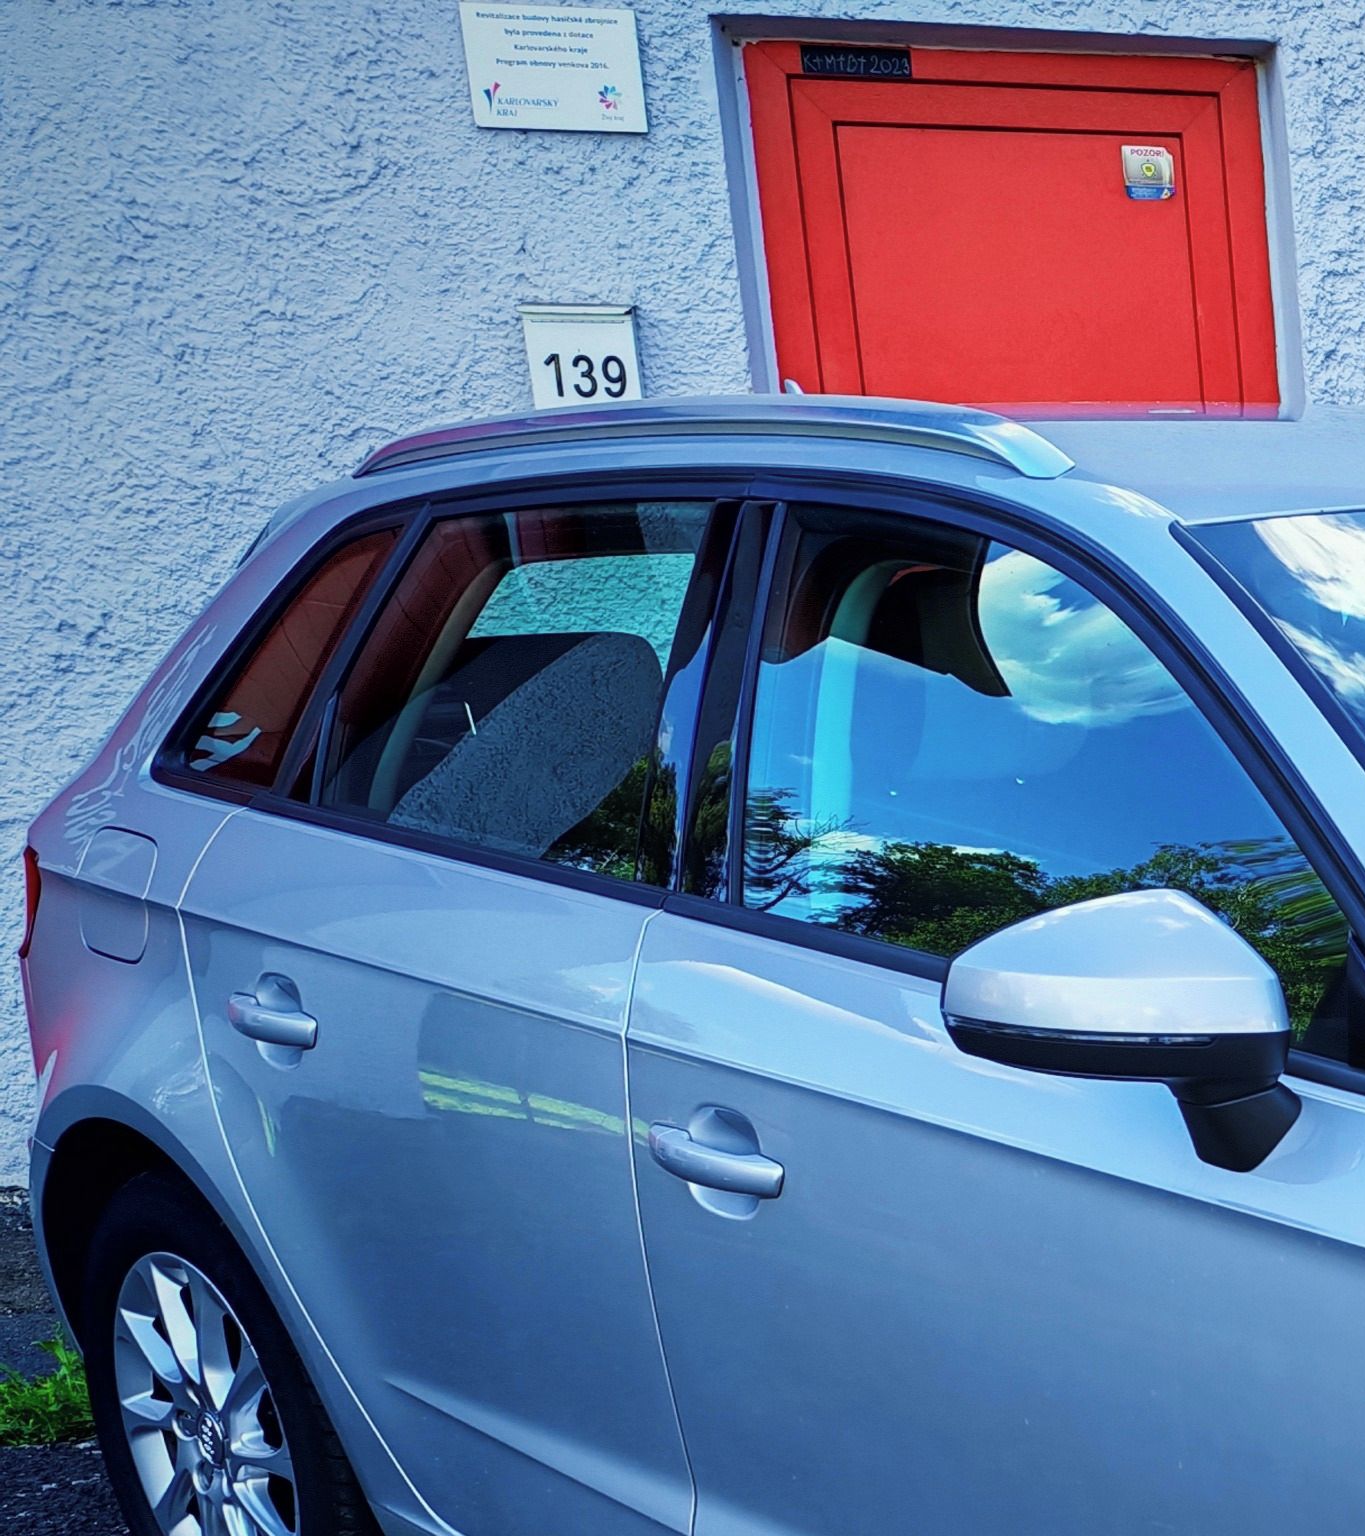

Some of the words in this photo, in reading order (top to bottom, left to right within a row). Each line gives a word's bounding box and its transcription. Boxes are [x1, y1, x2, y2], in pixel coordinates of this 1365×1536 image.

[476, 11, 520, 20] Revitalizace
[522, 14, 549, 23] budovy
[504, 28, 520, 36] byla
[522, 29, 561, 37] provedena
[514, 44, 567, 52] Karlovarského
[569, 45, 588, 54] kraje
[496, 58, 528, 67] Program
[530, 59, 556, 68] obnovy
[558, 61, 589, 69] venkova
[496, 108, 518, 117] KRAJ
[543, 353, 627, 398] 139
